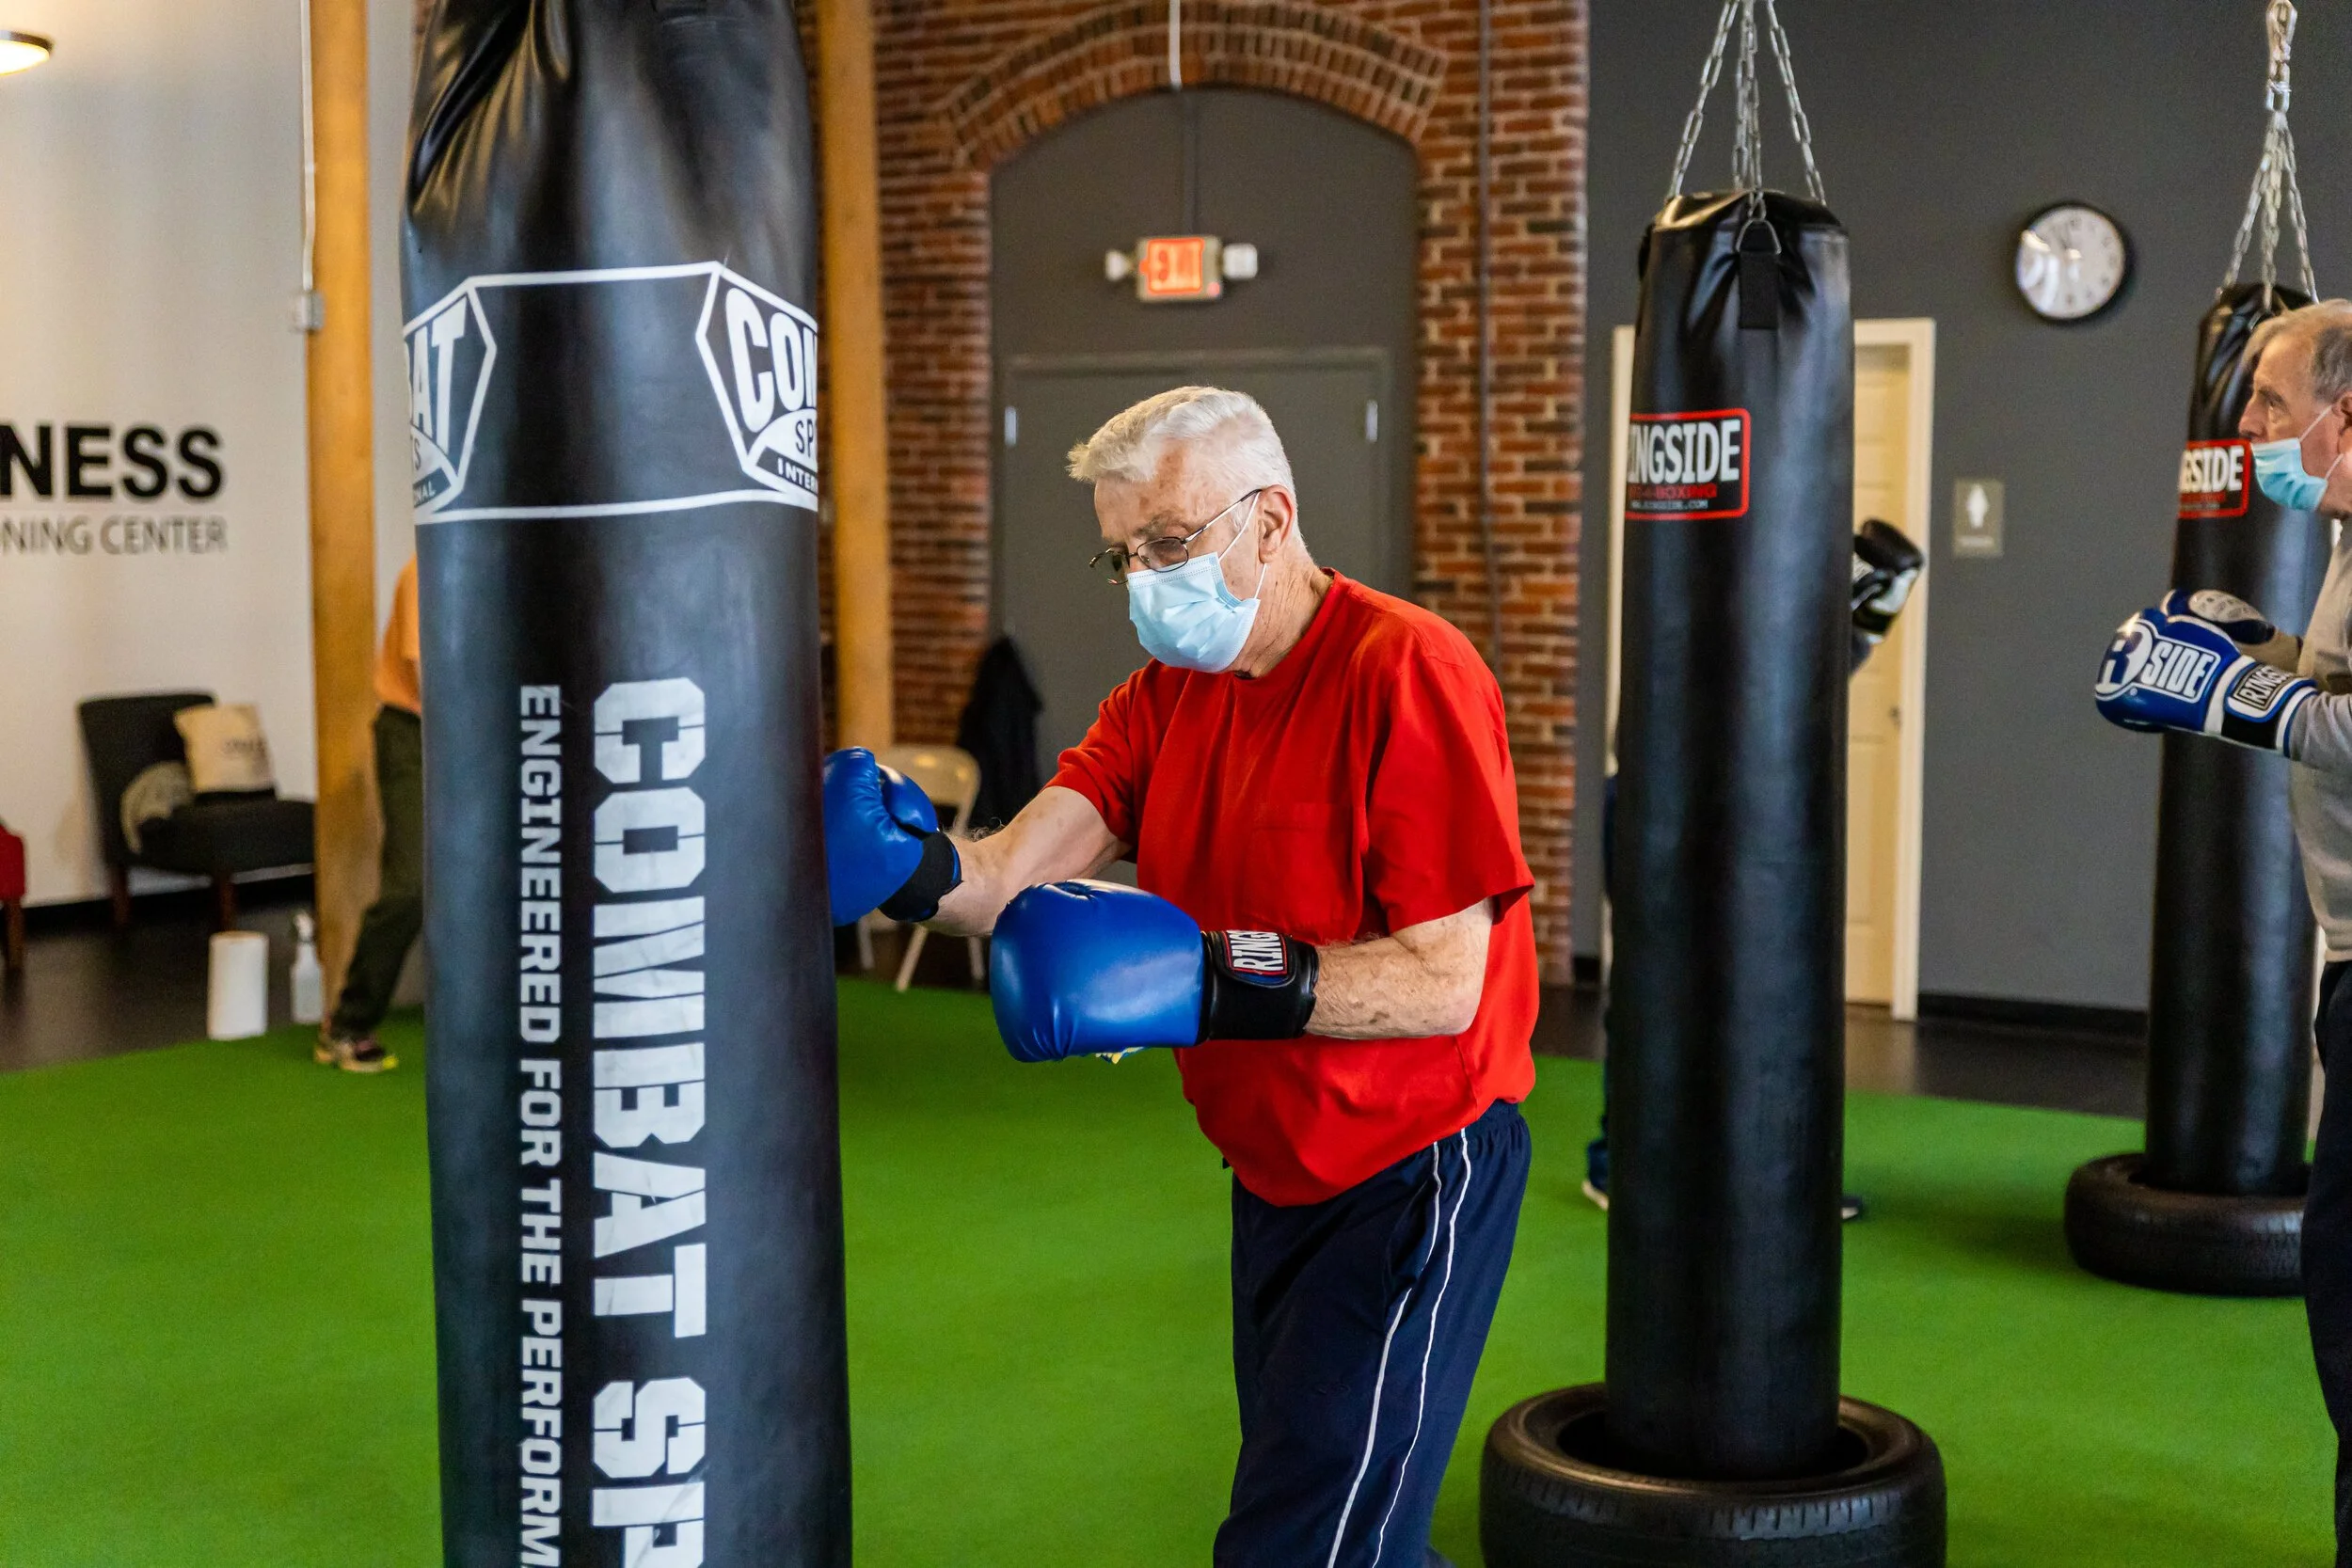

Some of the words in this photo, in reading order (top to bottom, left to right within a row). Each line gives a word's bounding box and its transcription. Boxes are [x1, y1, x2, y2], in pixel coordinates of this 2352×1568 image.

[406, 296, 468, 457] AT
[0, 424, 223, 499] NESS
[0, 516, 91, 555] NING
[100, 515, 229, 555] CENTER
[2139, 641, 2215, 699] SIDE
[520, 684, 562, 1043] ENGINEERED
[594, 677, 706, 1338] COMBAT
[520, 1059, 562, 1167] FOR
[520, 1179, 562, 1286] THE
[518, 1299, 562, 1568] PERFORM
